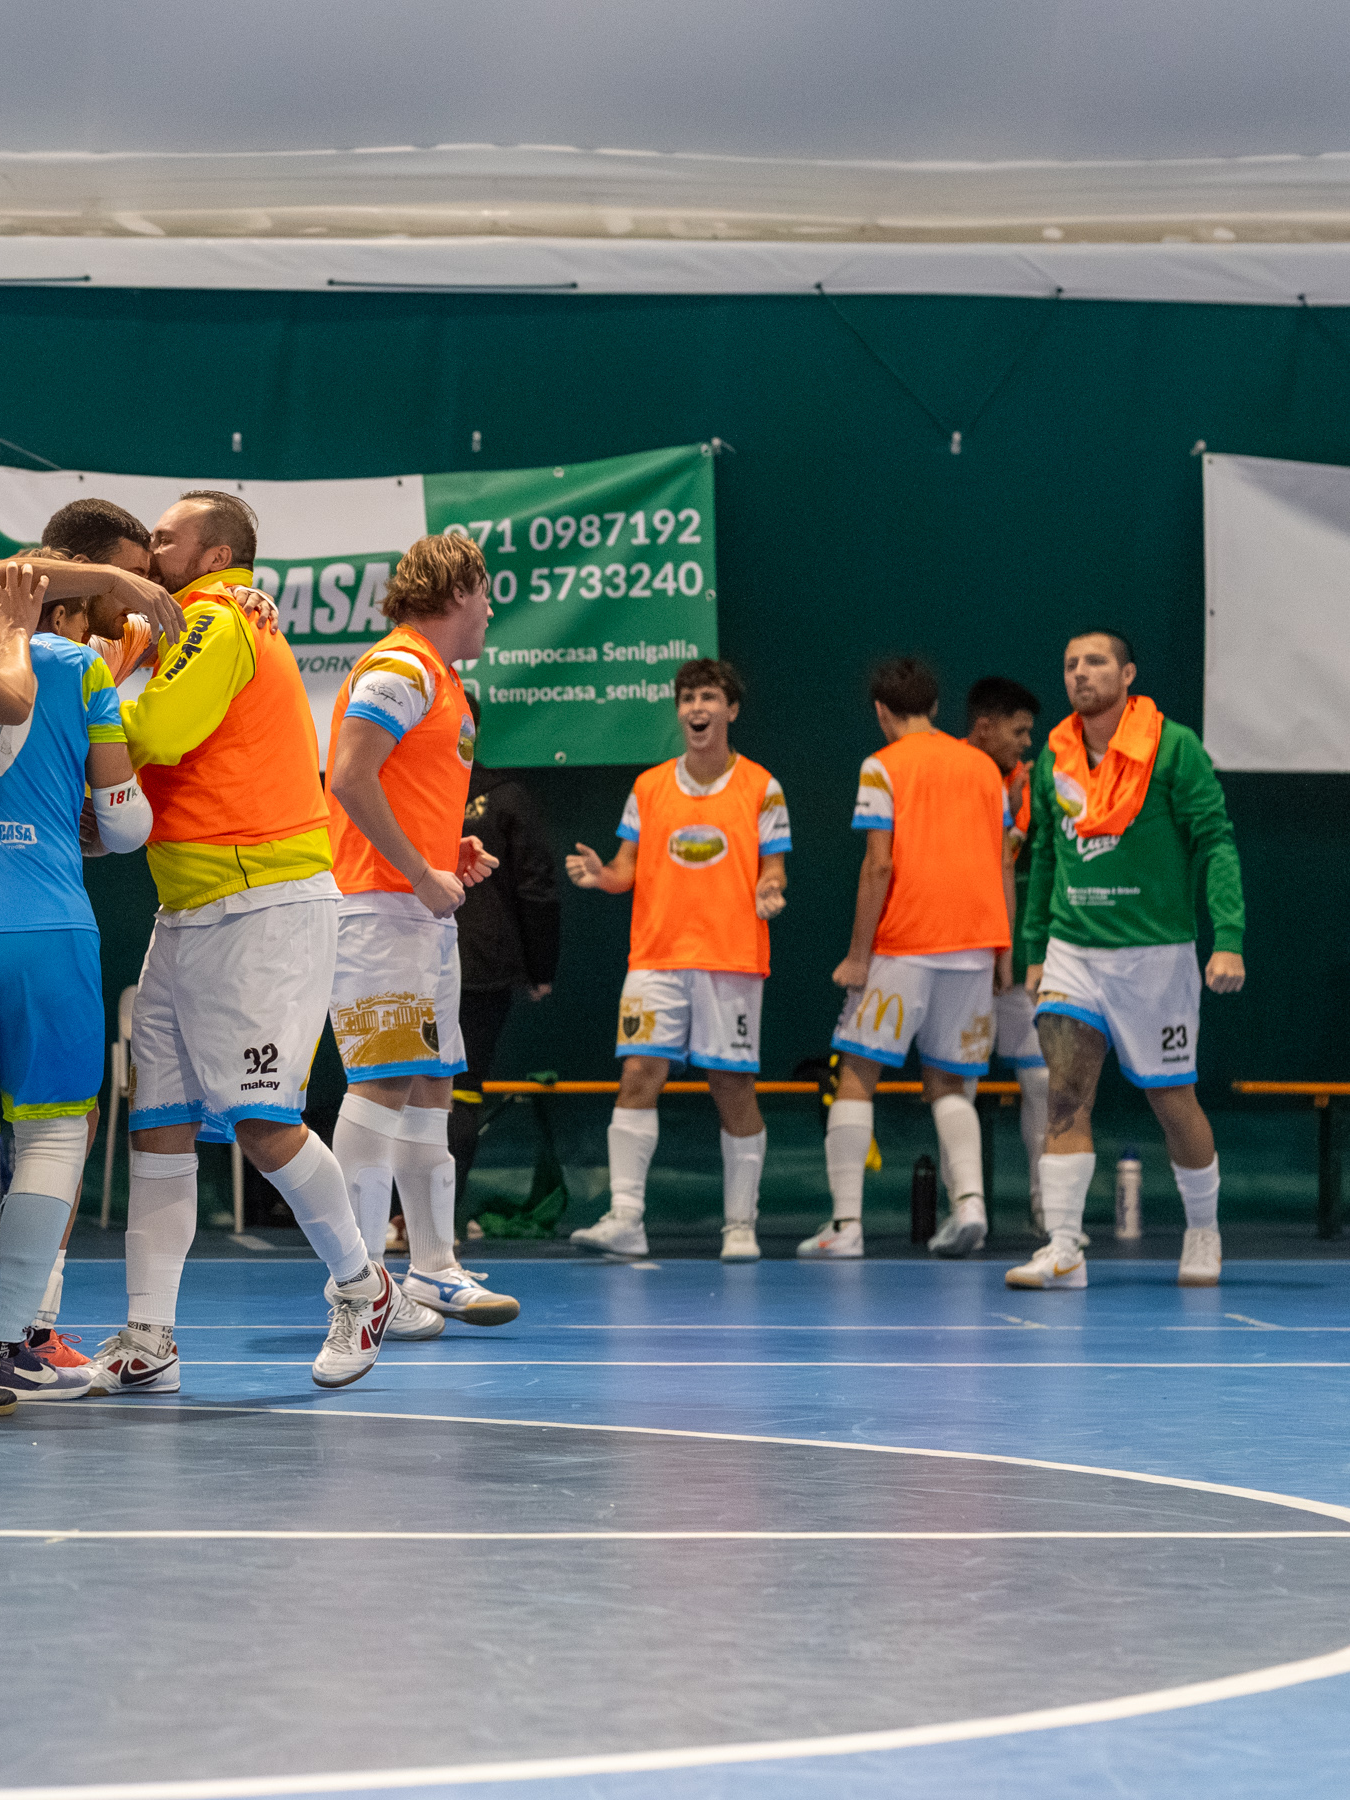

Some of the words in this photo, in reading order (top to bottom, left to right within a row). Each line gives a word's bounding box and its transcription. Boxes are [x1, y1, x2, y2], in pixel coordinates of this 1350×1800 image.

[529, 508, 701, 551] 0987192
[529, 561, 703, 602] 5733240
[164, 614, 216, 681] makay
[484, 646, 598, 669] Tempocasa
[602, 639, 699, 664] Senigallia
[1161, 1024, 1188, 1051] 23
[243, 1042, 279, 1075] 32
[240, 1079, 281, 1091] makay
